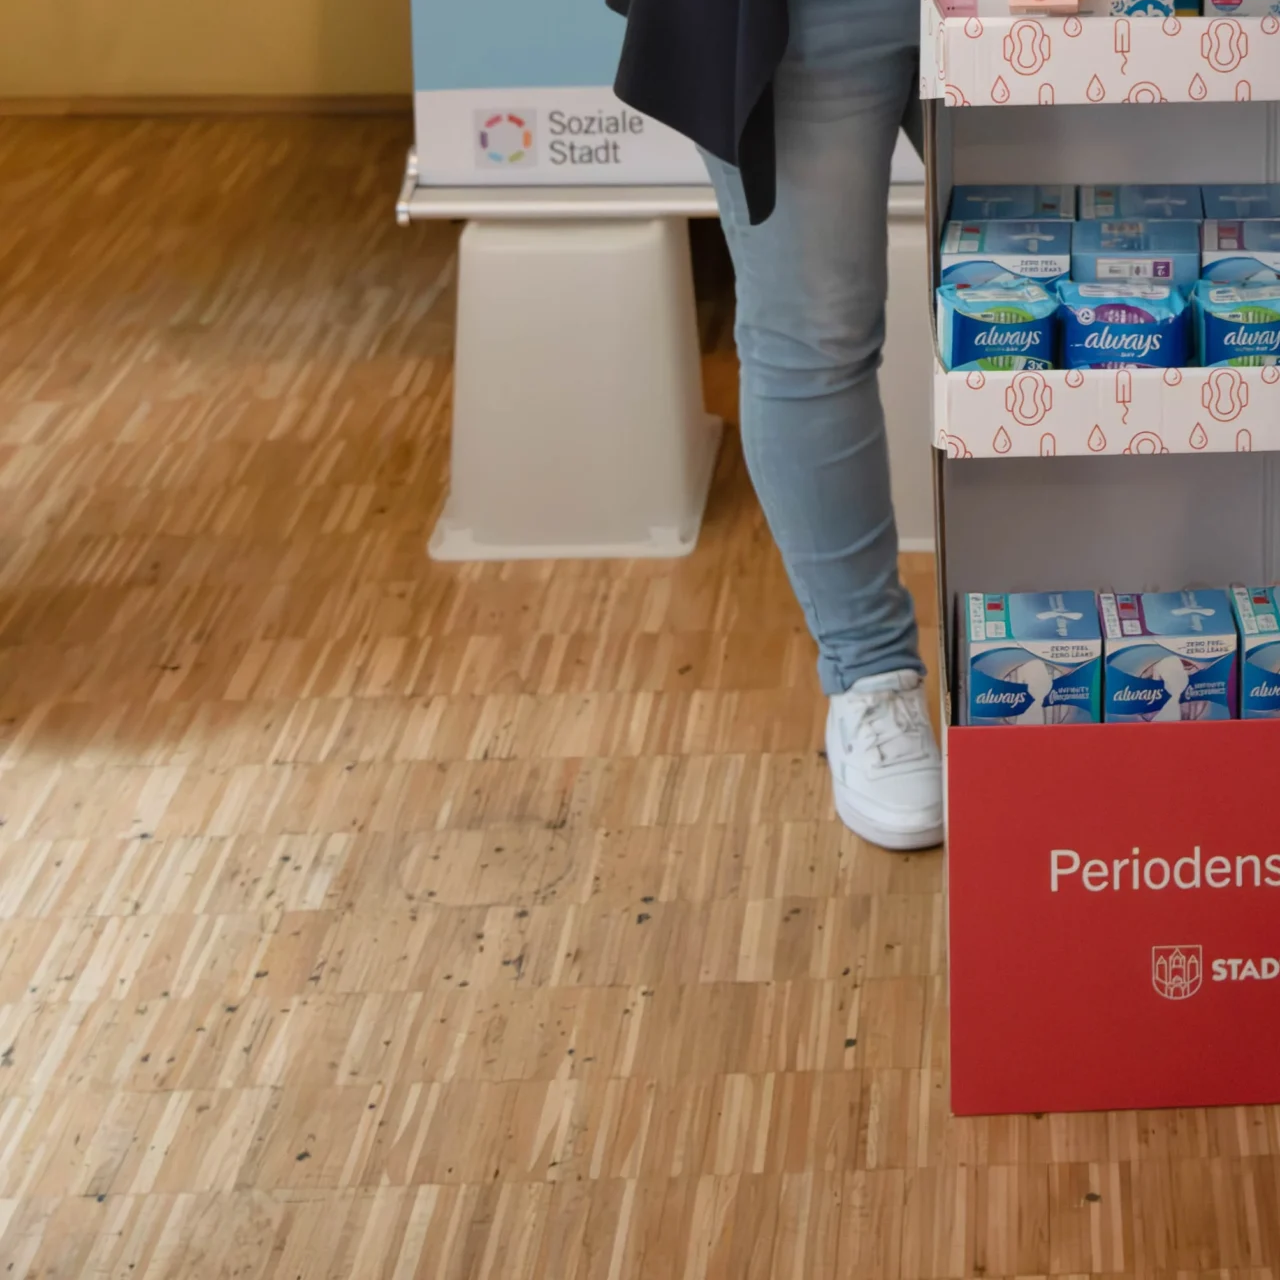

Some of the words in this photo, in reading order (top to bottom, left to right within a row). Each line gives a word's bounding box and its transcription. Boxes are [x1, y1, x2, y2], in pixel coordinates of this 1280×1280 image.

[549, 110, 644, 136] Soziale
[549, 139, 621, 166] Stadt
[974, 326, 1042, 352] always
[1084, 325, 1162, 358] always
[1027, 360, 1044, 370] 3x
[976, 688, 1027, 708] always
[1113, 685, 1163, 705] always
